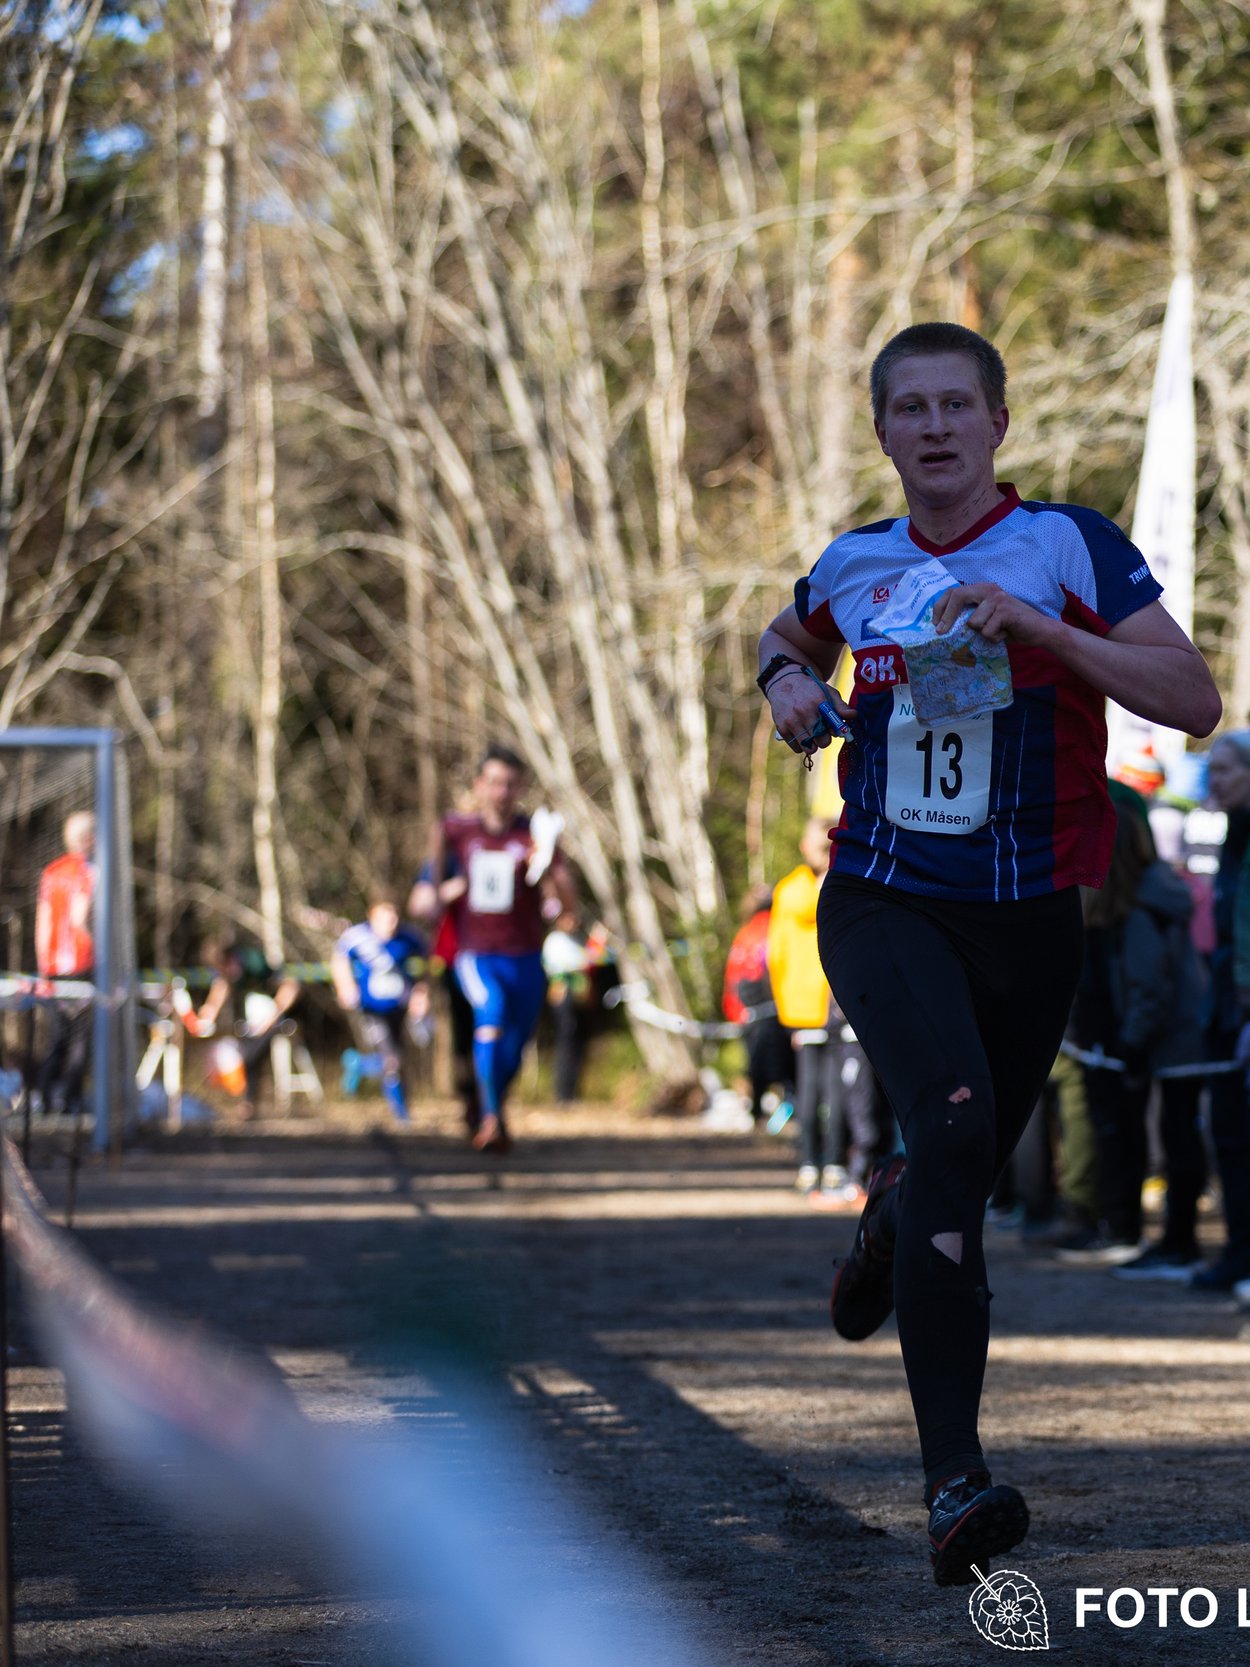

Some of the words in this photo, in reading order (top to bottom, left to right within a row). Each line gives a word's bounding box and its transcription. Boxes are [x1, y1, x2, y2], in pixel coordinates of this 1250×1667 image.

[1128, 563, 1150, 585] TRIM
[872, 587, 890, 601] ICA
[860, 655, 896, 684] OK
[915, 730, 963, 800] 13
[900, 808, 922, 822] OK
[926, 810, 971, 826] Måsen
